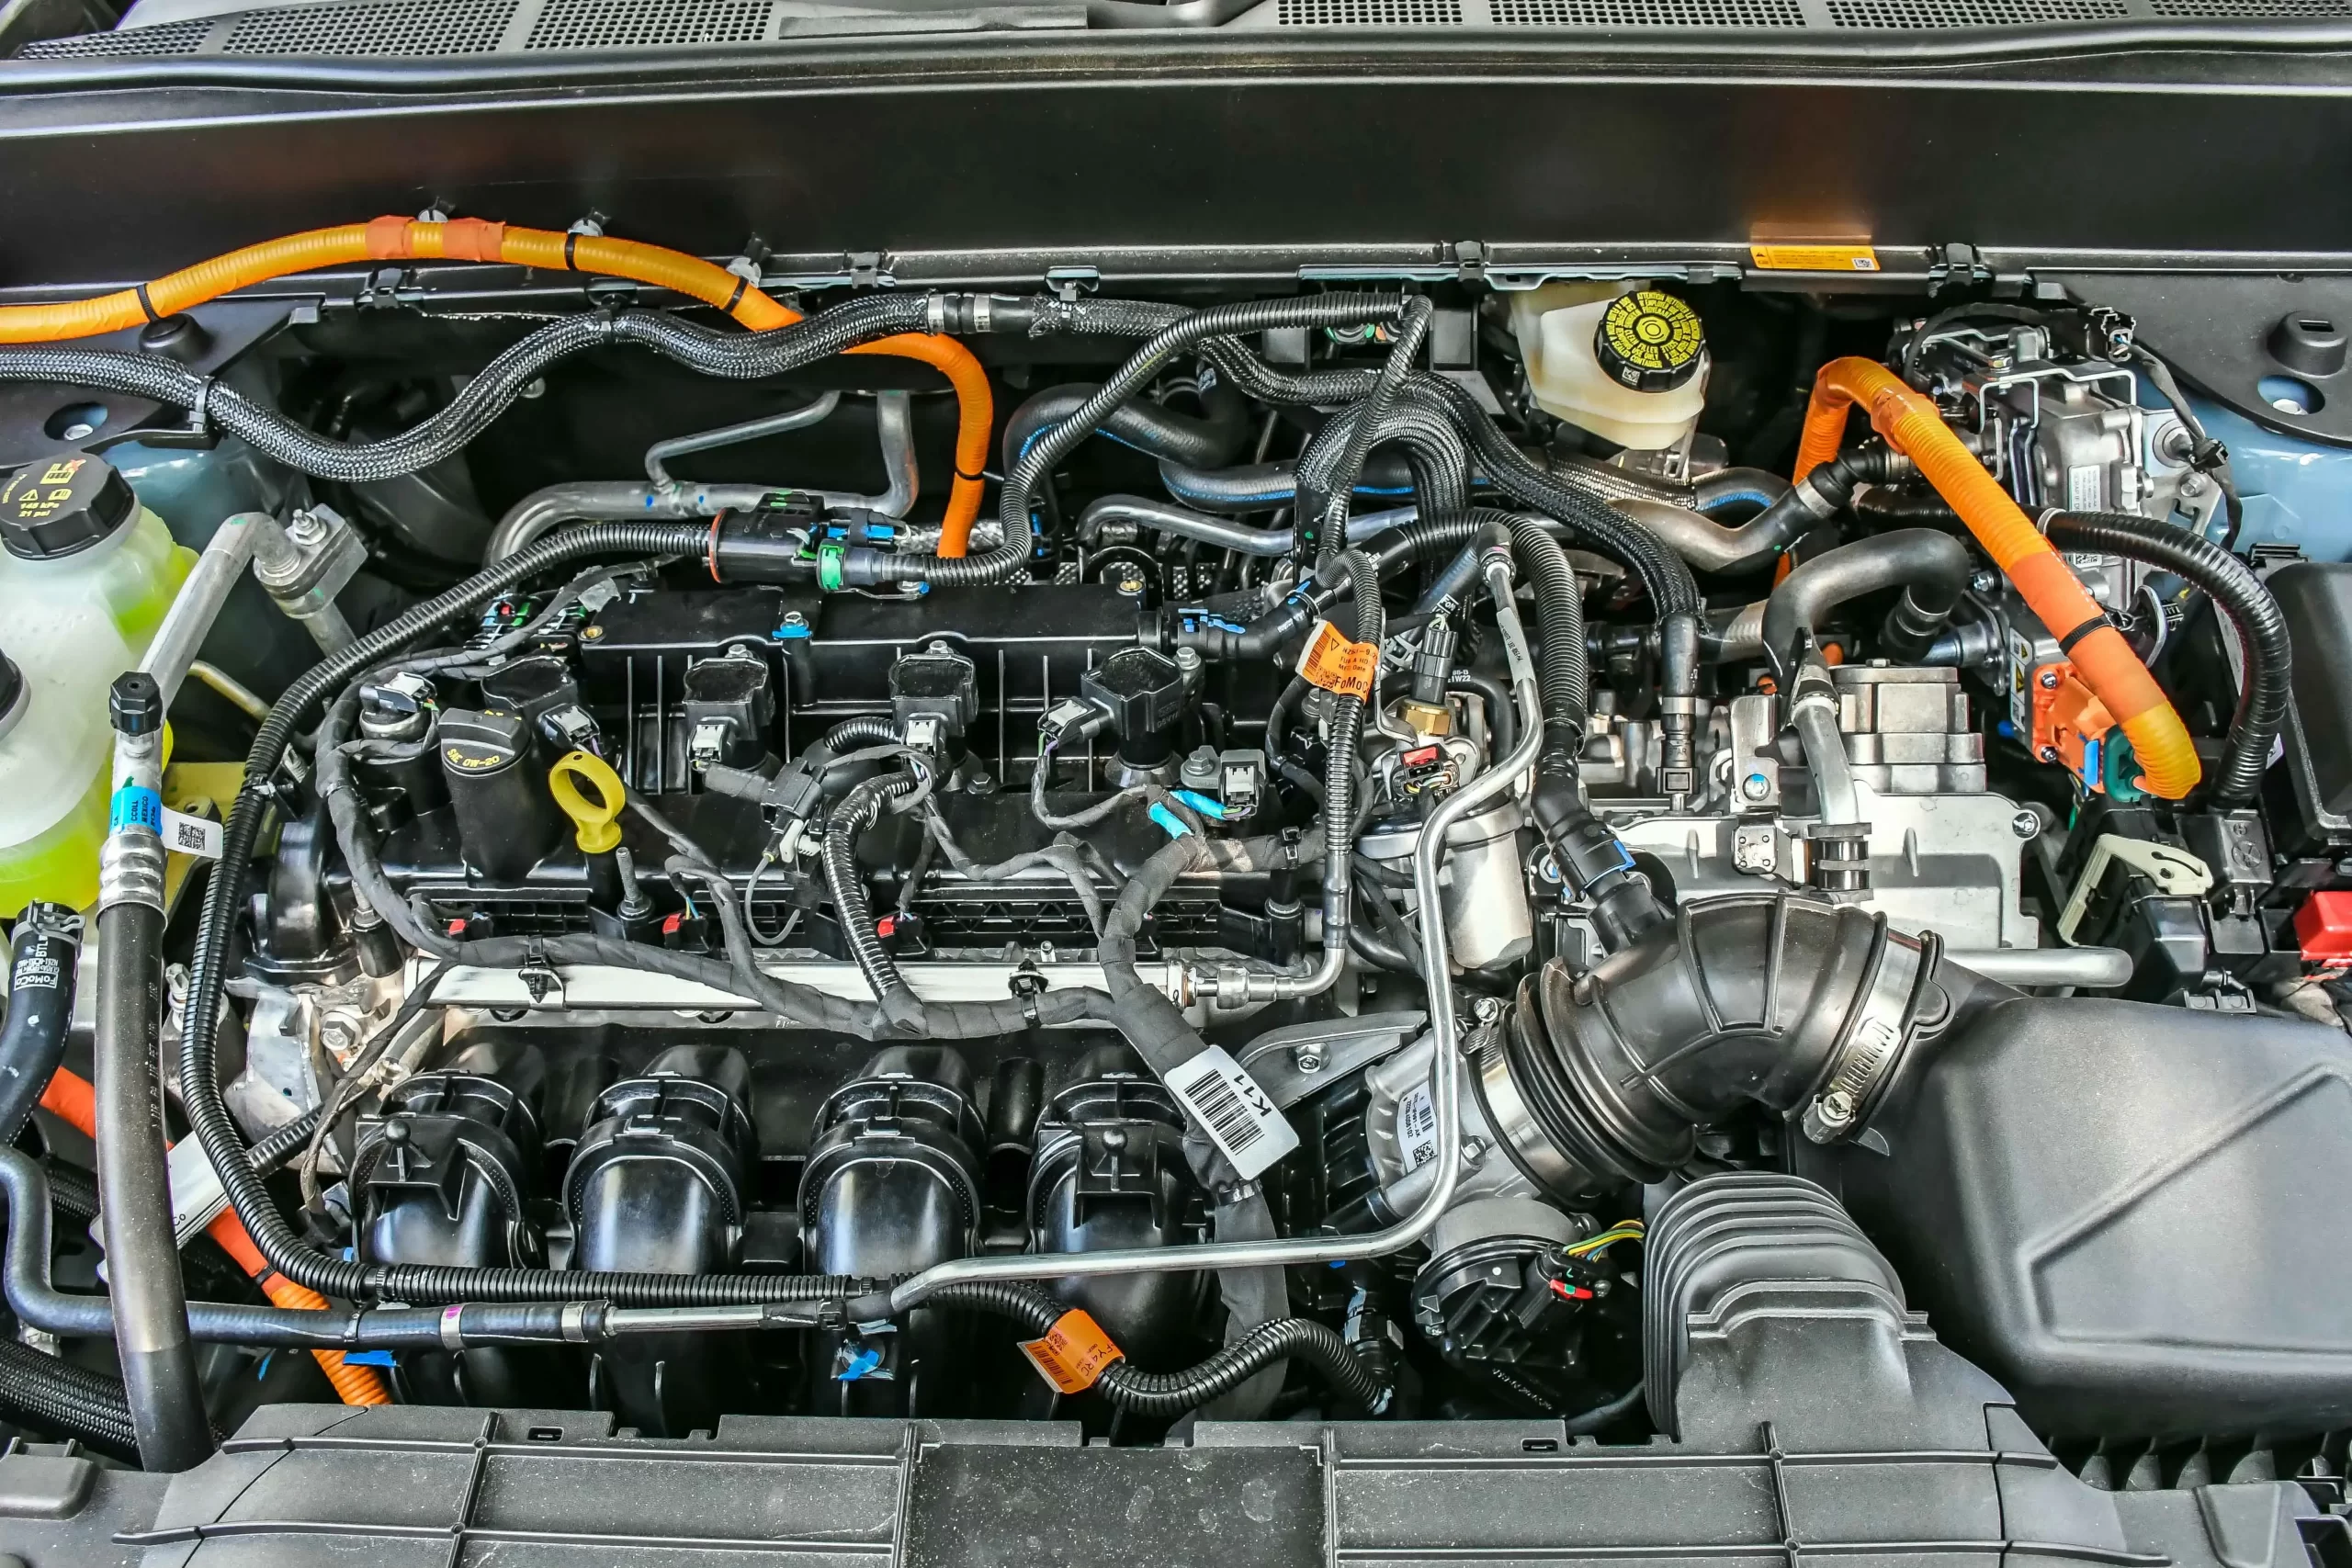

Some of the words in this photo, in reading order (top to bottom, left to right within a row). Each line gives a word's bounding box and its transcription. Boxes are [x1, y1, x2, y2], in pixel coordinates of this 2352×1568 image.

[1611, 341, 1631, 357] SEALED
[447, 749, 463, 763] SAE
[17, 976, 55, 986] FoMoCo
[1233, 1074, 1272, 1117] K11
